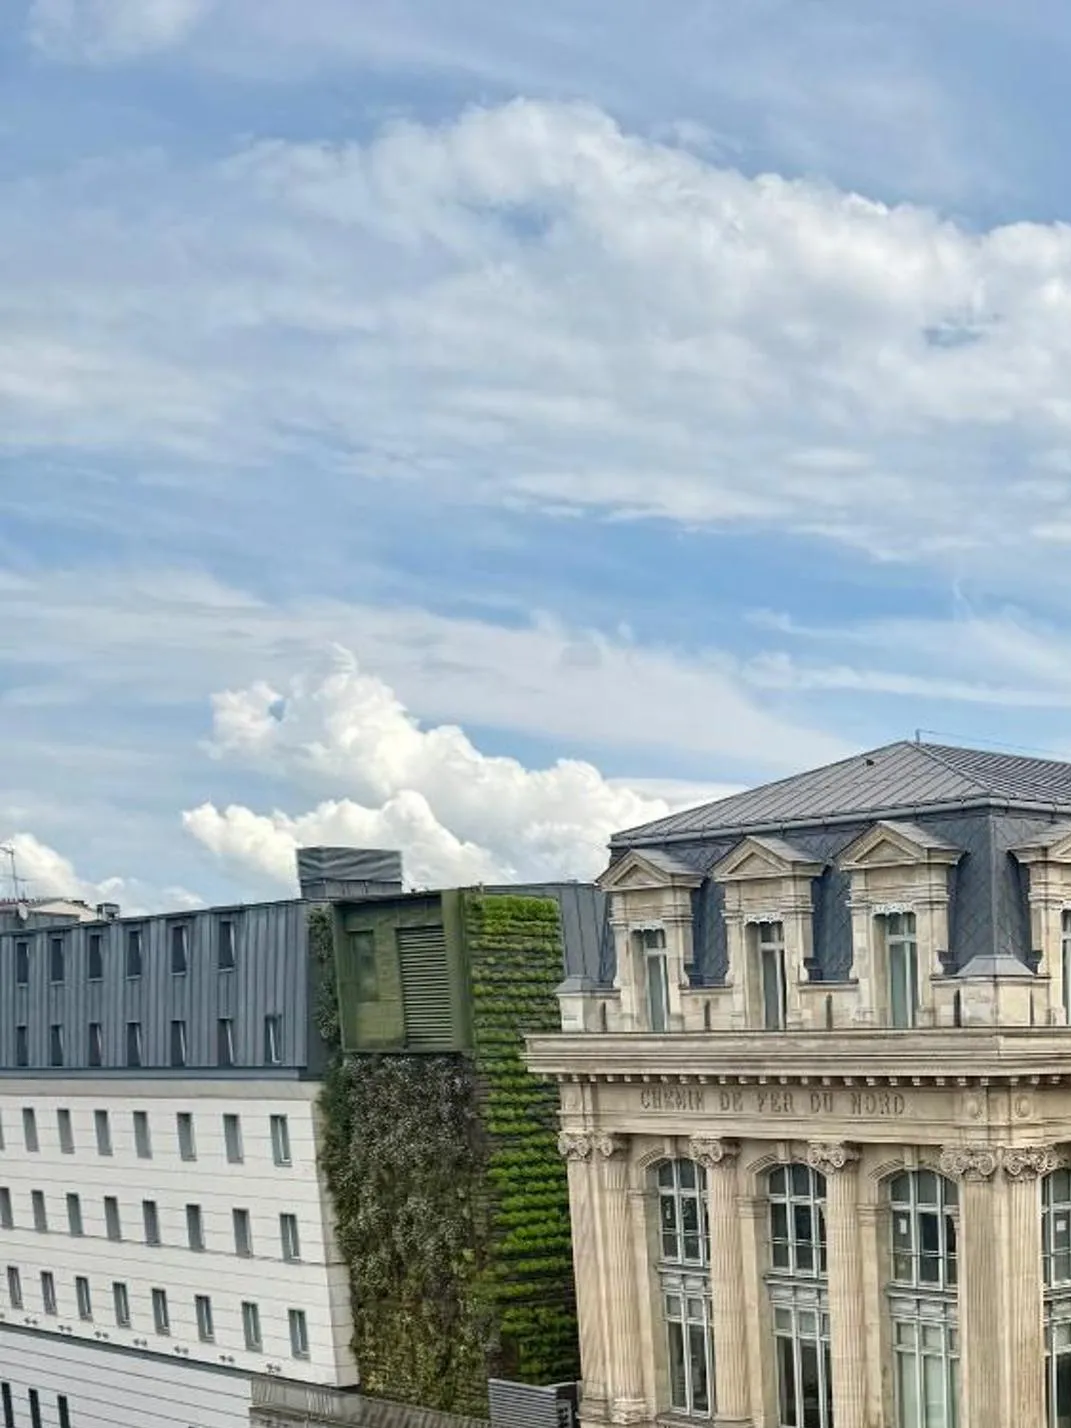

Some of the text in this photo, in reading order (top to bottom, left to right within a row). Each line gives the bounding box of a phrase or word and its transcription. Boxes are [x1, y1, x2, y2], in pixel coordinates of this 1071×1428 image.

[640, 1088, 906, 1116] CHEMIN DE FER DU NORD
